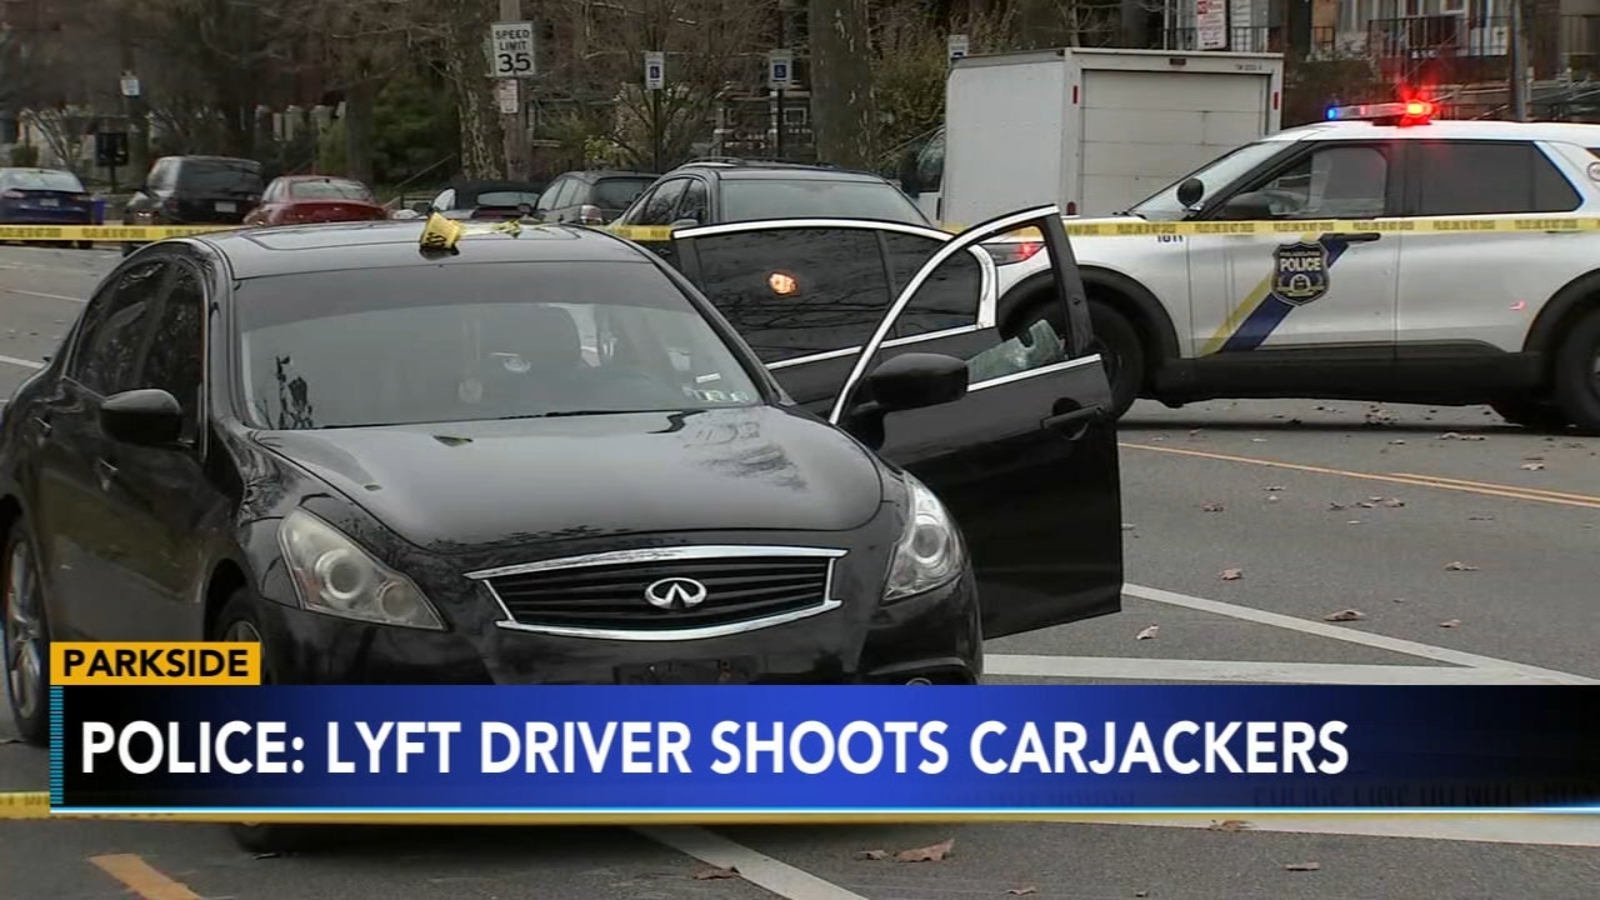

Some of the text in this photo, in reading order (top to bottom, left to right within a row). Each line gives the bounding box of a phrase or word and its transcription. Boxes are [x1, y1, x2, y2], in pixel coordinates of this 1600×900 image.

[495, 29, 530, 39] SPEED
[500, 41, 527, 50] LIMIT
[498, 53, 531, 72] 35
[1280, 258, 1321, 271] POLICE
